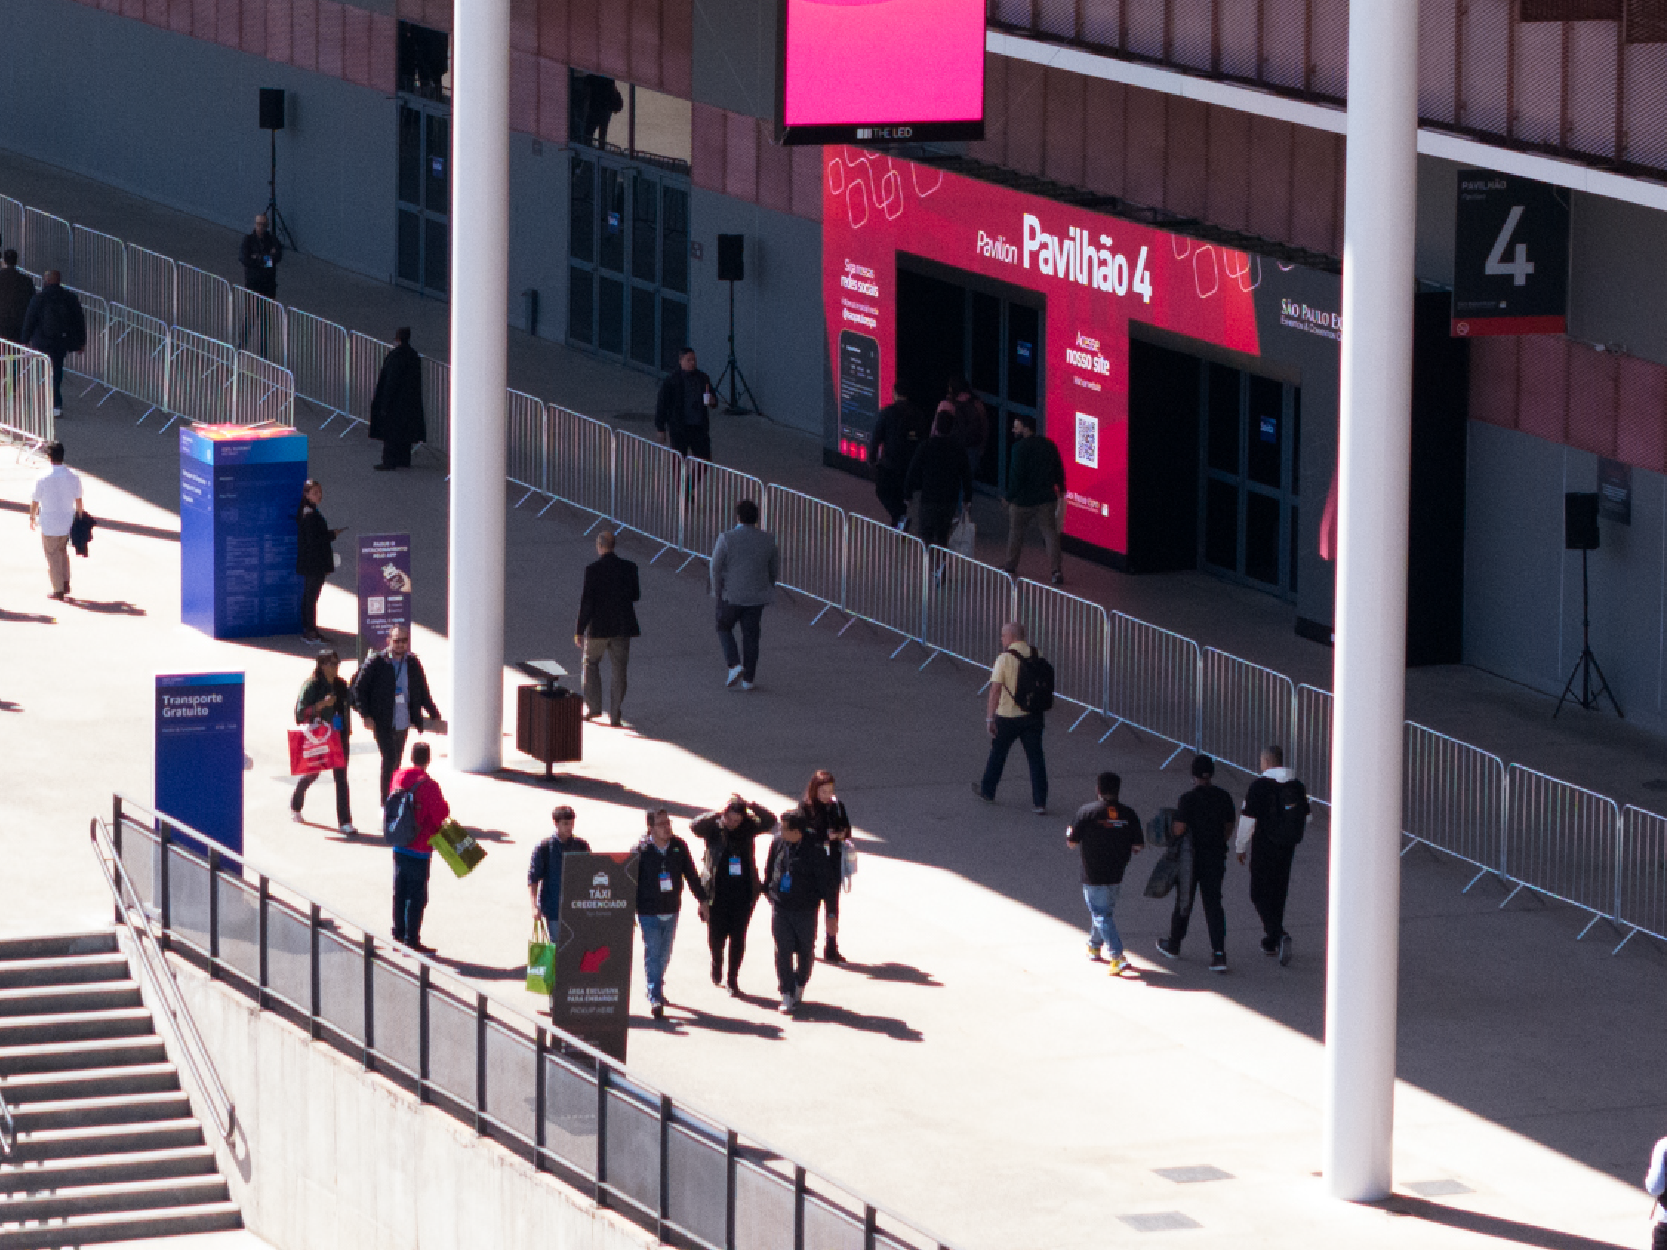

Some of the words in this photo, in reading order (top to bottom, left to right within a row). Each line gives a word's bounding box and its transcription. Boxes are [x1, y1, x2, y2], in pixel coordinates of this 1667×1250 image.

[892, 127, 913, 139] LED
[1485, 205, 1535, 287] 4
[976, 230, 1018, 265] Pavilion
[1023, 213, 1129, 296] Pavilhão
[1132, 246, 1153, 304] 4
[1066, 348, 1092, 370] nosso
[1093, 352, 1110, 375] site
[161, 693, 223, 706] Transporte
[161, 706, 209, 717] Gratuito
[589, 887, 612, 899] TÁXI
